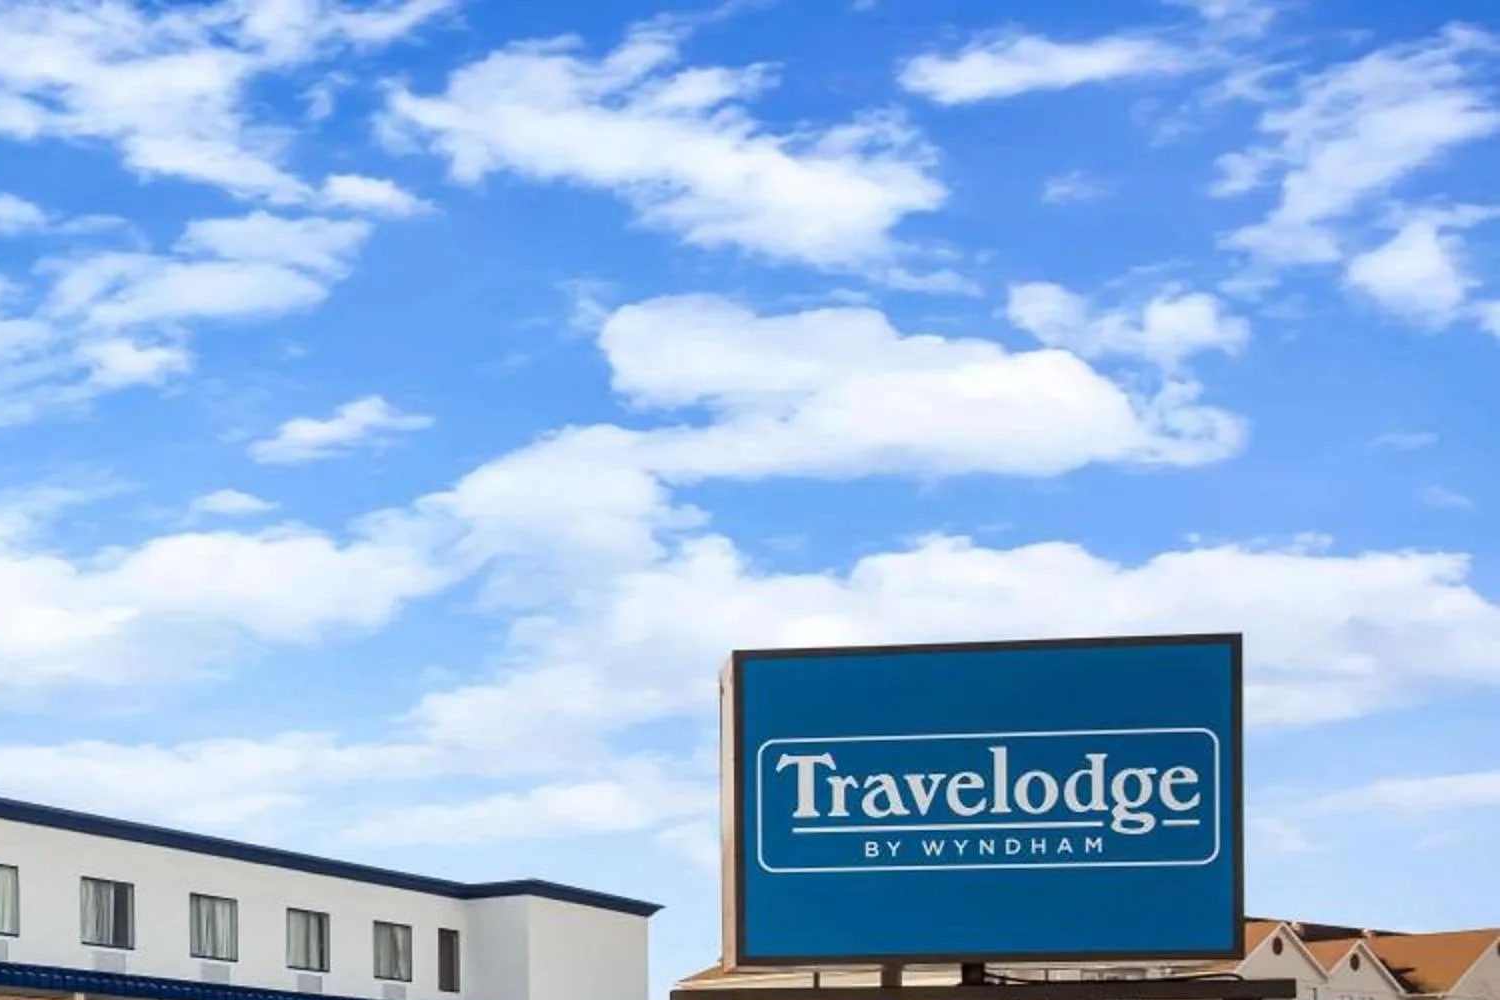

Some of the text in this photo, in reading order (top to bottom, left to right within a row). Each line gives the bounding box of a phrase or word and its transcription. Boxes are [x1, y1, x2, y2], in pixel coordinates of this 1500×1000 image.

[775, 746, 1201, 836] Travelodge
[865, 836, 1105, 858] BY WYNDHAM
